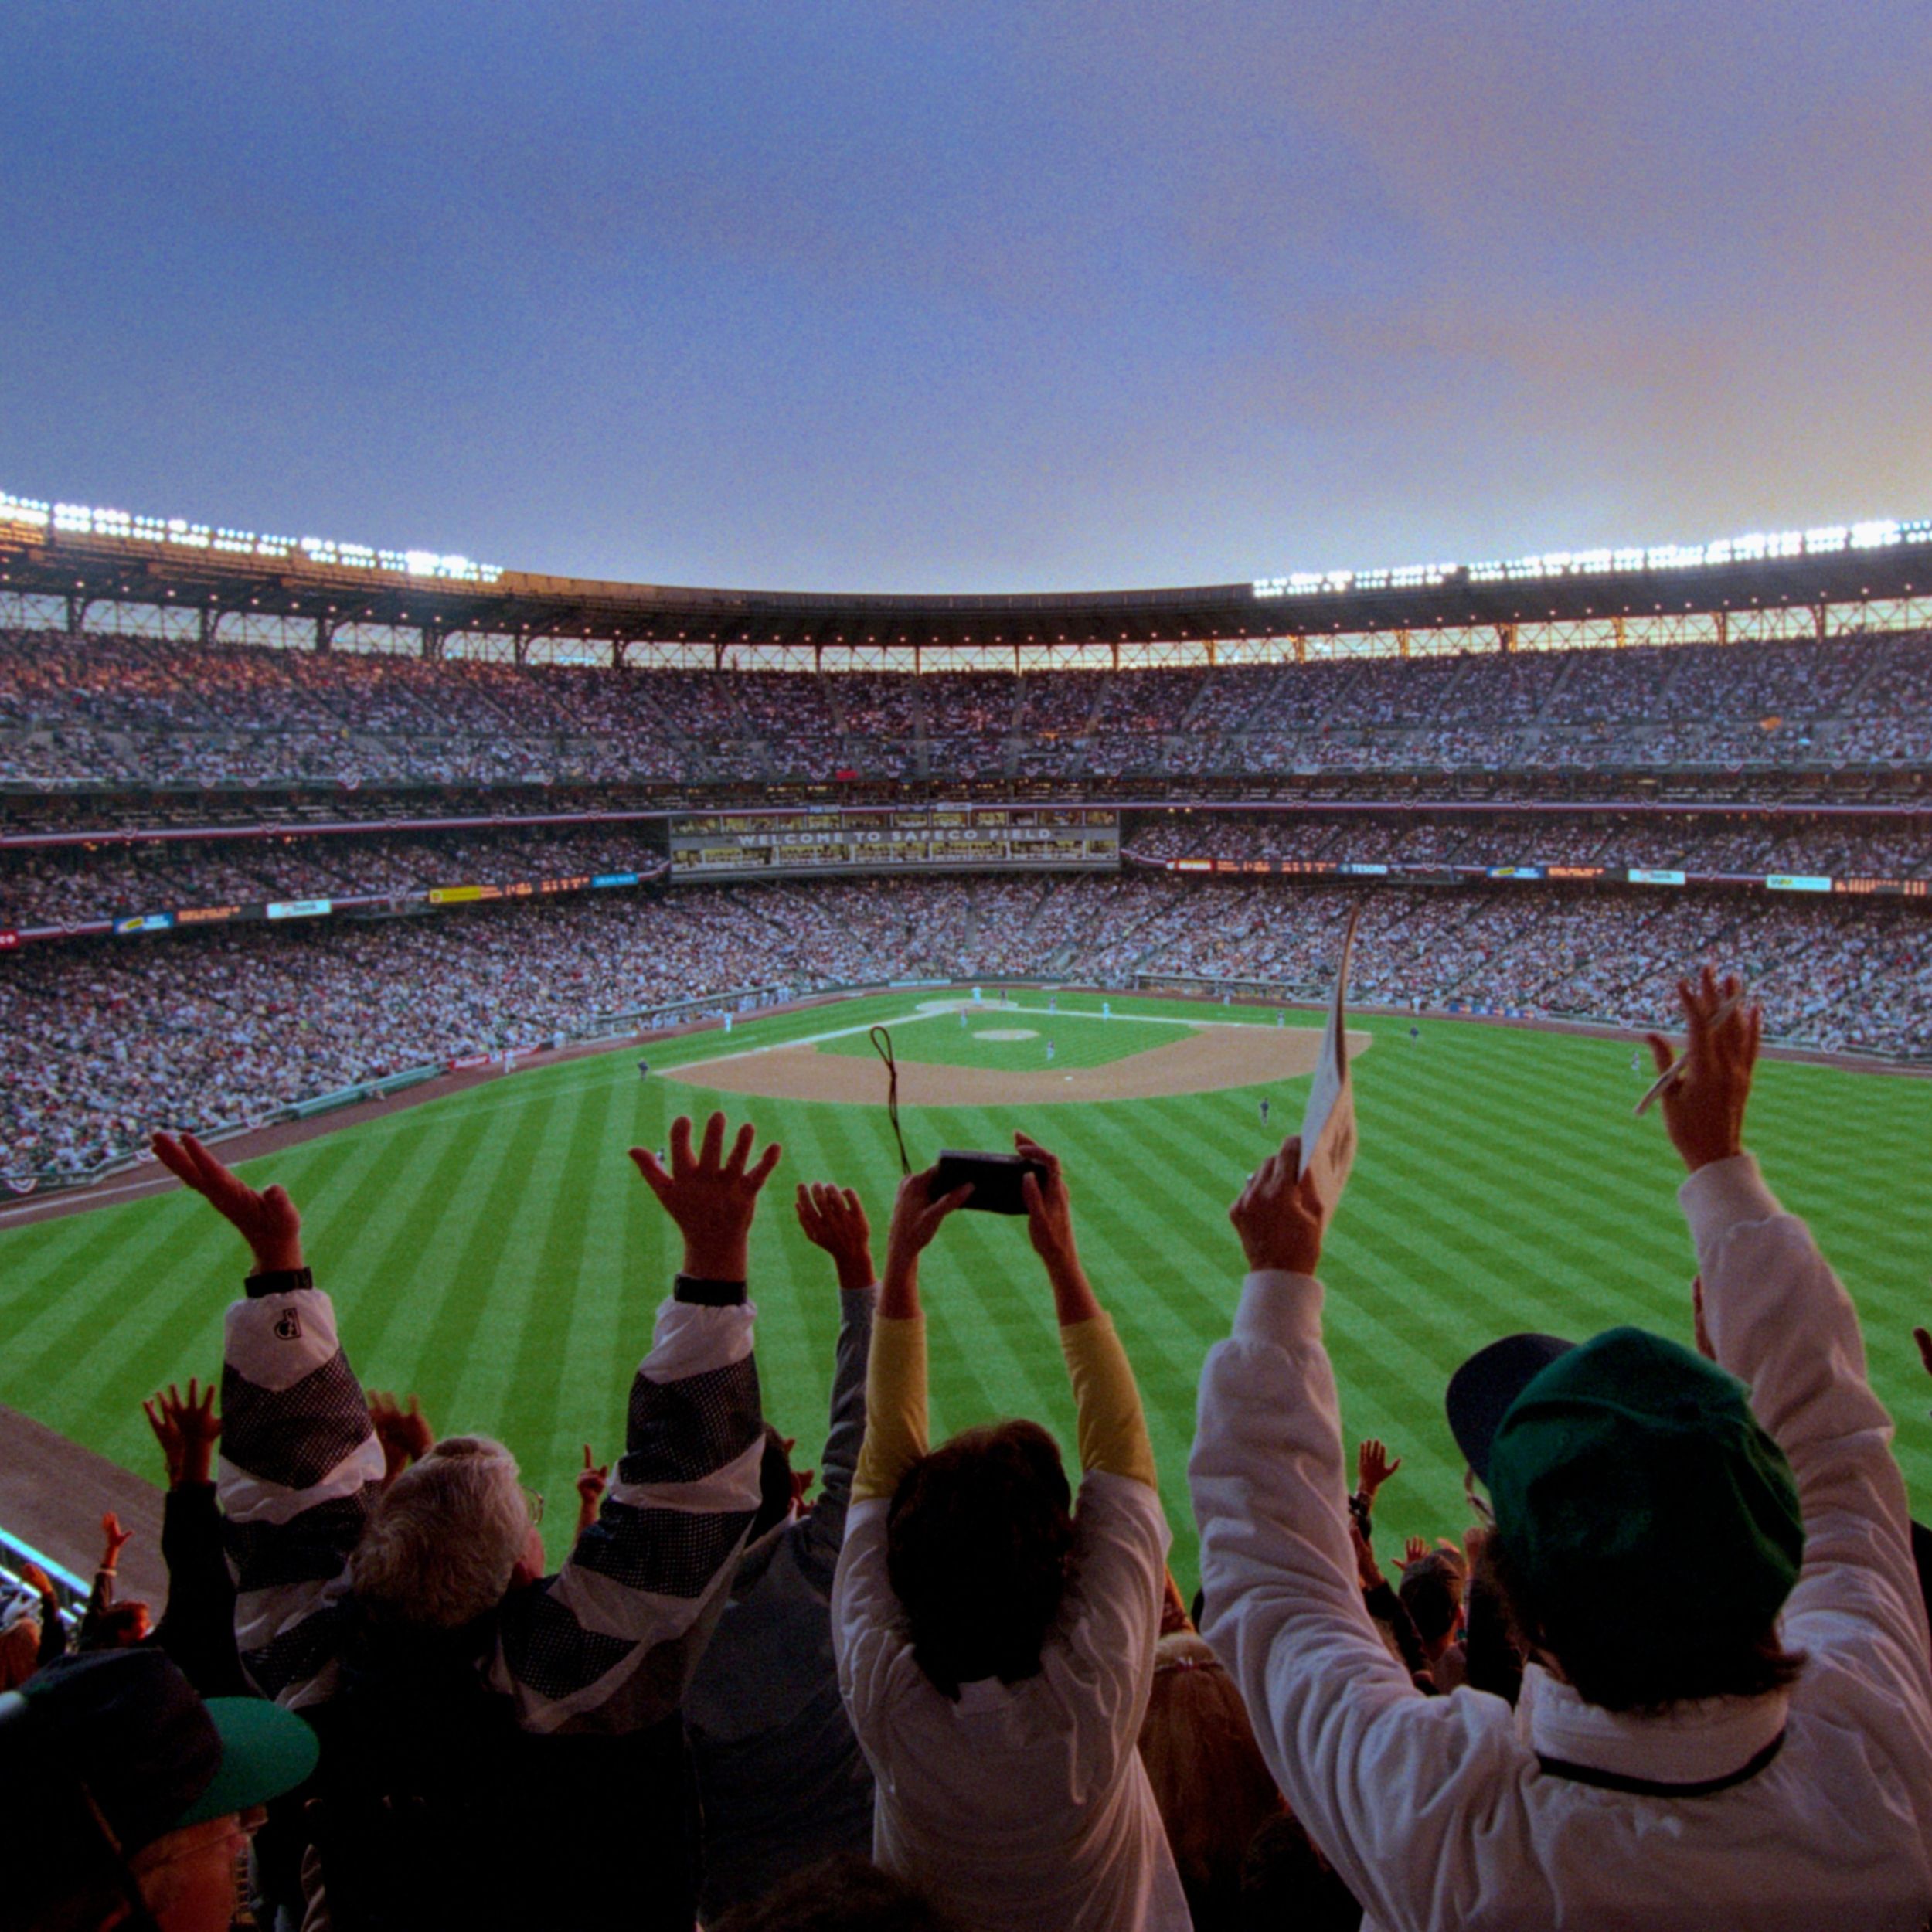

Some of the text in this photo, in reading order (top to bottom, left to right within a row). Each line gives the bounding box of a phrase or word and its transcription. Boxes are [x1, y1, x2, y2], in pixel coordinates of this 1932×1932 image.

[738, 828, 1051, 846] WELCOME TO SAFECO FIELD
